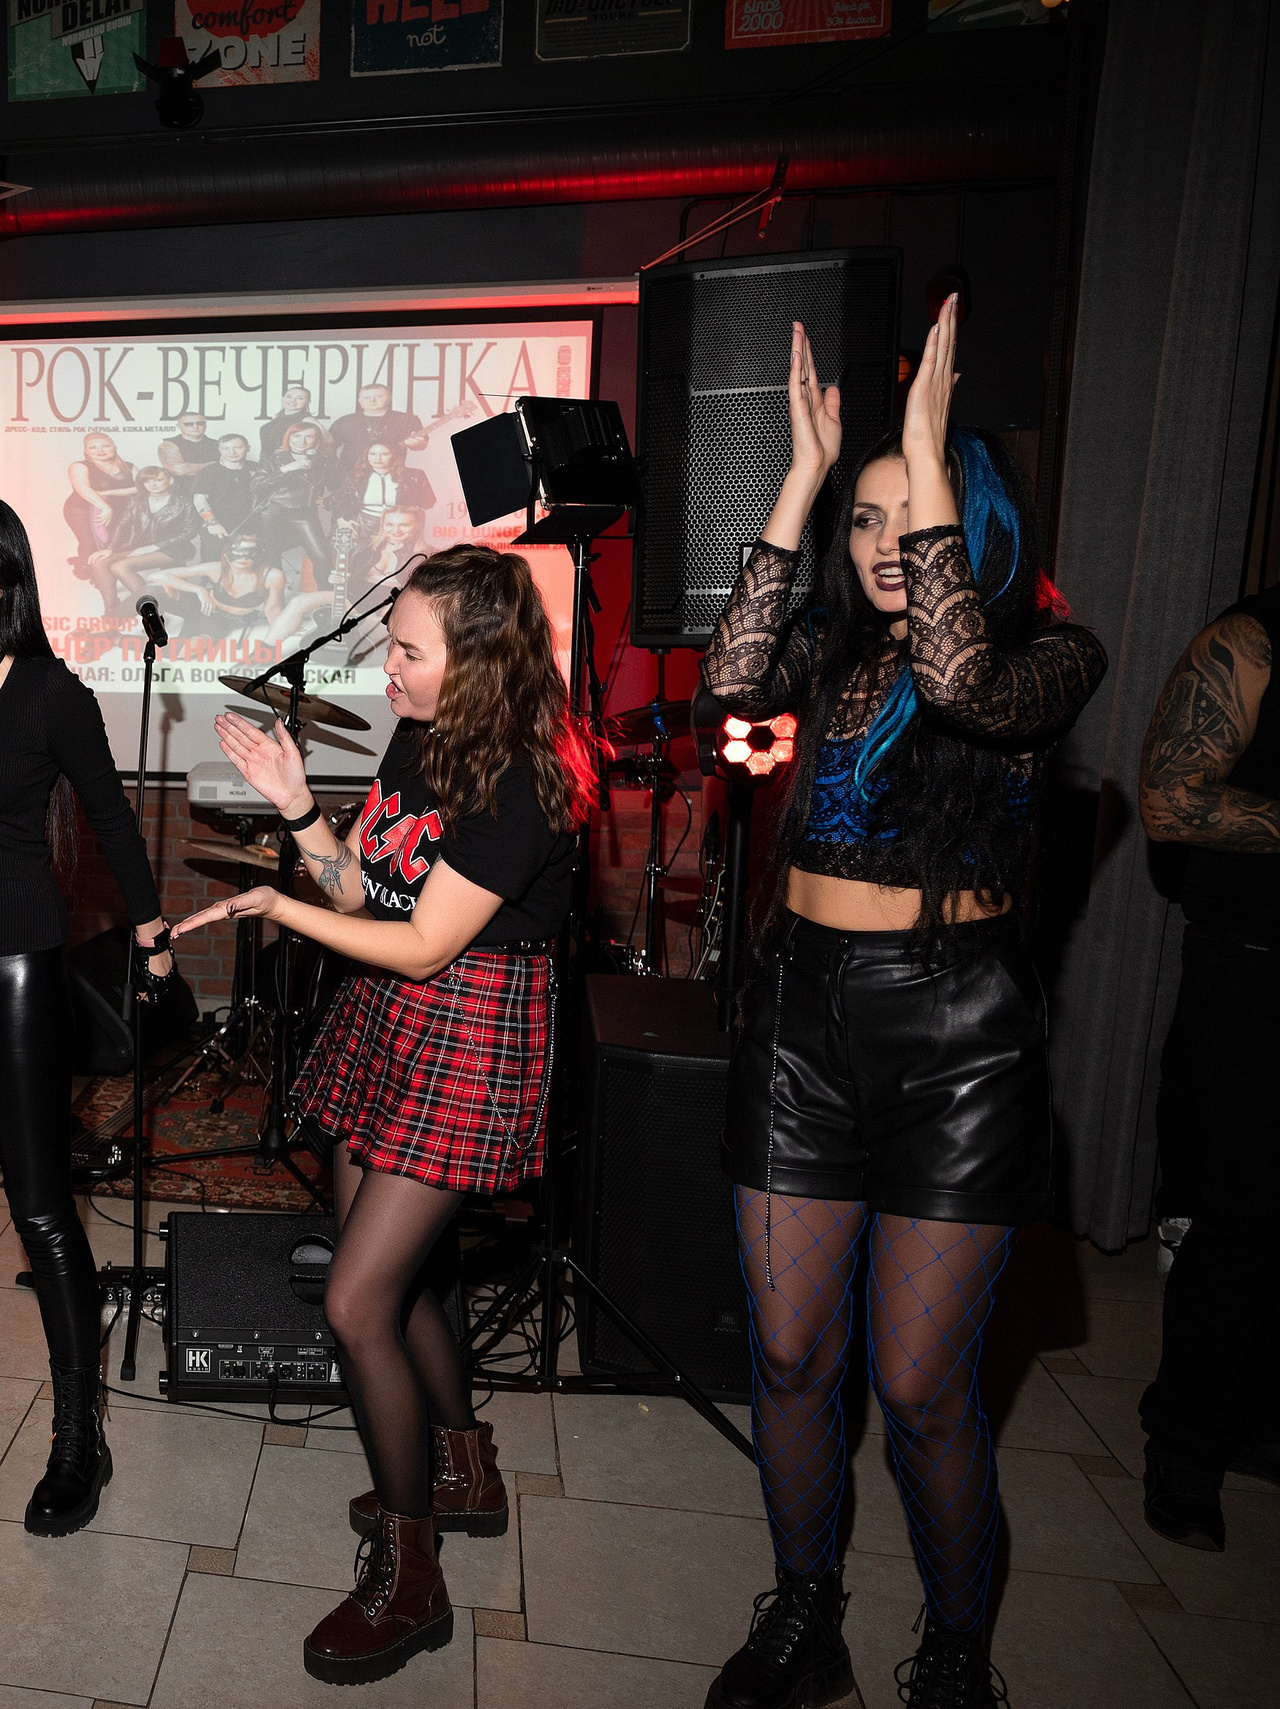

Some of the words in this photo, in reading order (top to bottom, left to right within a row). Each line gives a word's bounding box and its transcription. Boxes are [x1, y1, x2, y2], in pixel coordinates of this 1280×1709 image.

[192, 0, 297, 35] comfort
[740, 12, 784, 32] 2000
[407, 24, 447, 48] not
[432, 527, 457, 538] BIG
[462, 526, 523, 538] LOUNGE
[76, 616, 139, 632] GROUP
[122, 637, 283, 666] ПТНИЦЫ
[721, 1315, 736, 1325] JBL
[188, 1350, 209, 1368] HK
